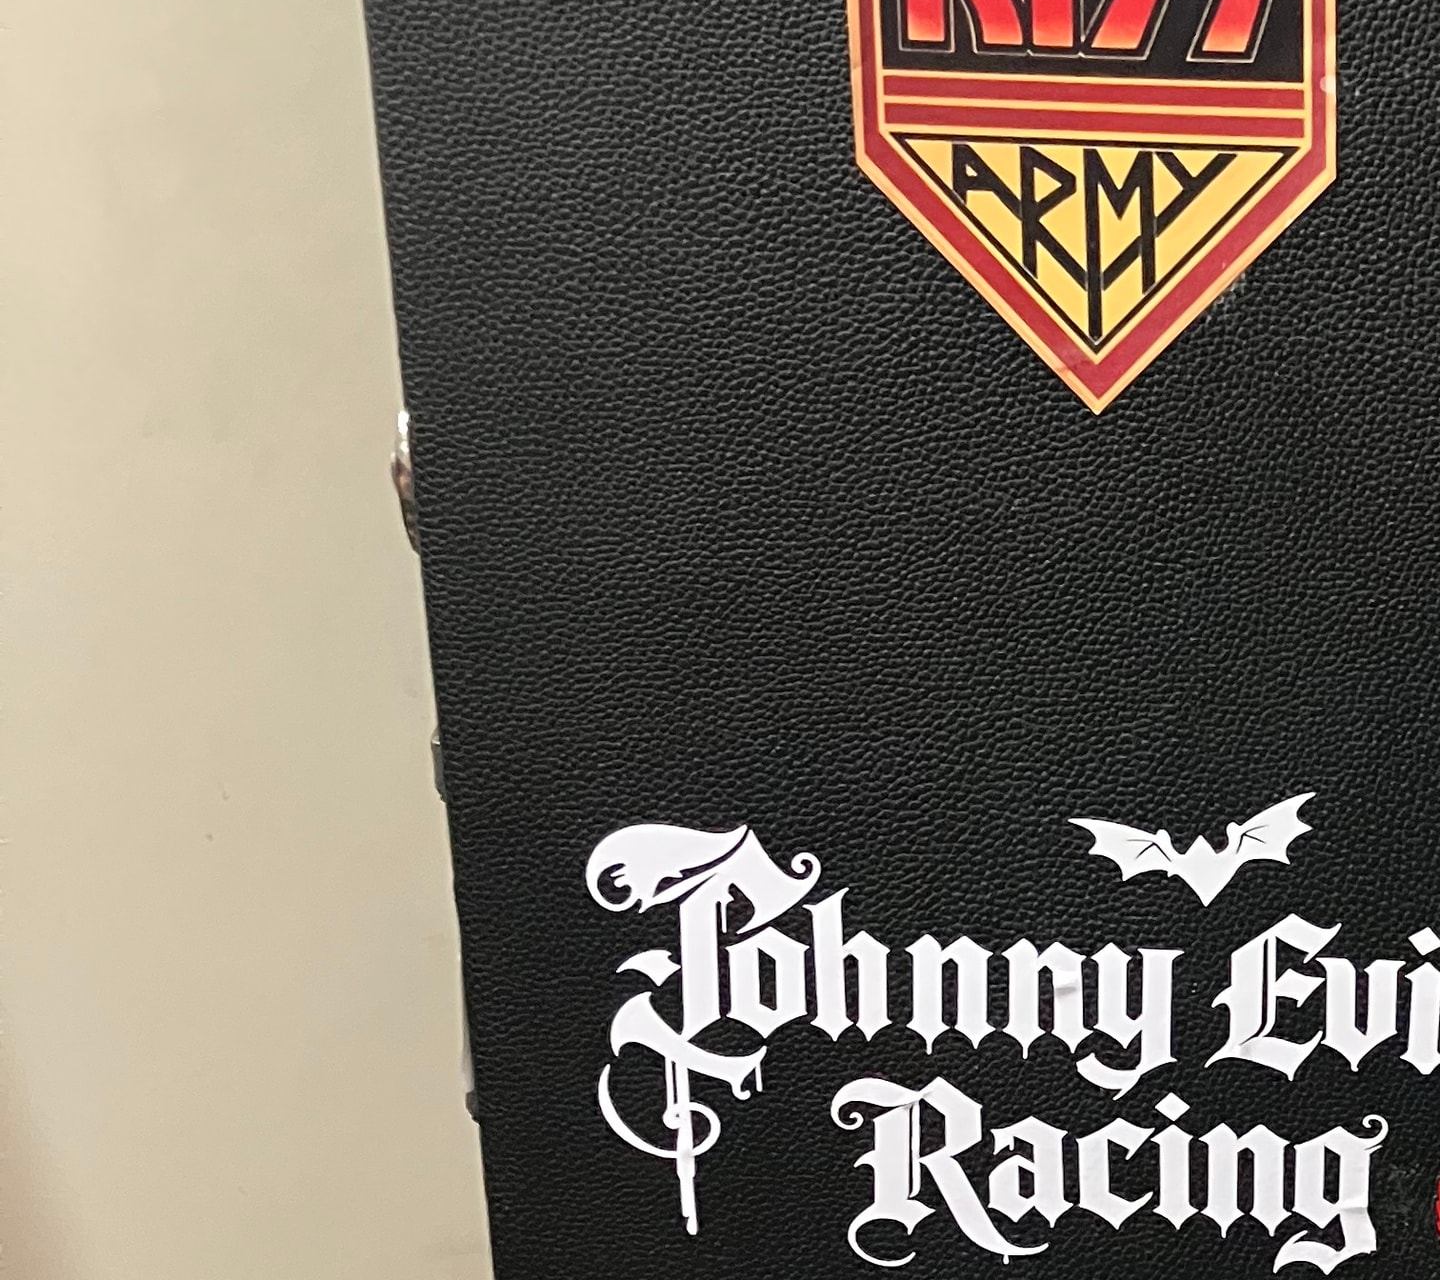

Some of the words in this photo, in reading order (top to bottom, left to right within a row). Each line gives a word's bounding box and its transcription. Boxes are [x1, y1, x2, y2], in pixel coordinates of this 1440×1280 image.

[951, 142, 1237, 341] ARMY
[585, 823, 1185, 1236] Johnny
[831, 1075, 1389, 1275] Racing
